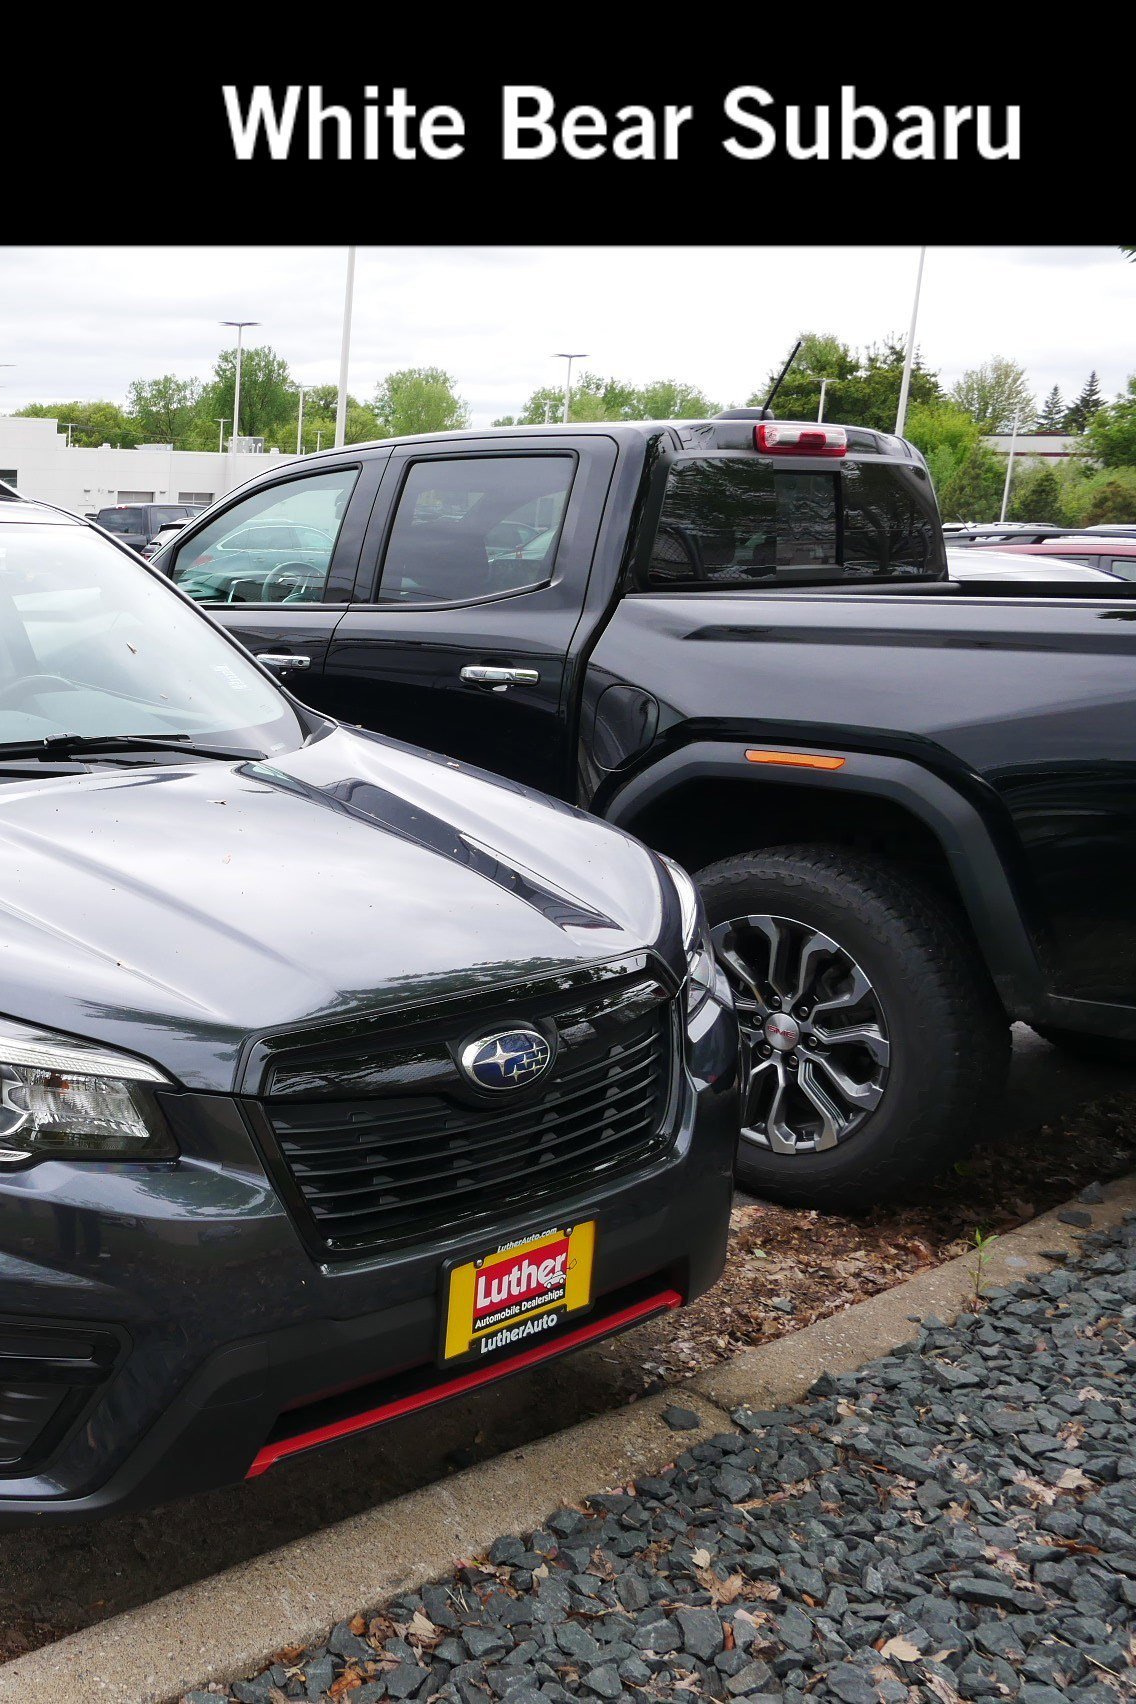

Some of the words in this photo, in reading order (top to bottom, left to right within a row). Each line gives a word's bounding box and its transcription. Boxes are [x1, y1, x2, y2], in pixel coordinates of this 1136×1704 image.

[767, 1024, 796, 1040] GMC
[497, 1227, 557, 1253] LutherAuto.com
[476, 1252, 567, 1309] Luther
[475, 1305, 520, 1329] Automobile
[521, 1288, 564, 1311] Dealerships
[480, 1313, 558, 1354] LutherAuto
